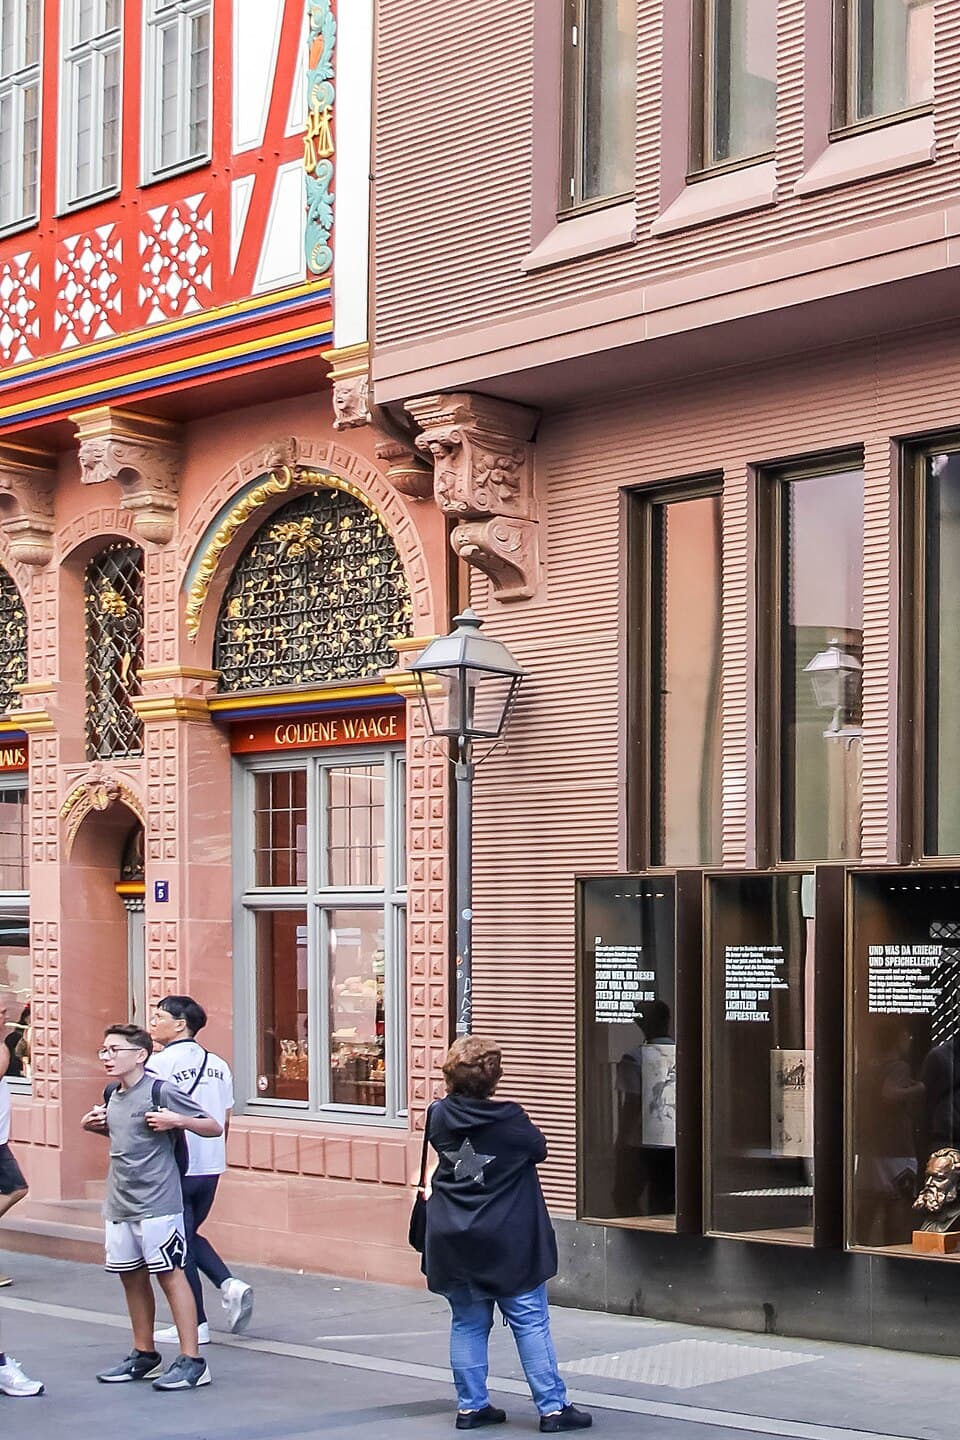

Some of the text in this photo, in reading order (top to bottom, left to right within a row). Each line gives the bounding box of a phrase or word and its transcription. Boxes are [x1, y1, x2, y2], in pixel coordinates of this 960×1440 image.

[274, 715, 397, 744] GOLDENE WAAGE
[868, 945, 883, 956] UND
[884, 945, 900, 956] WAS
[901, 945, 911, 956] DA
[868, 956, 884, 967] UND
[172, 1067, 225, 1083] NEW ORK
